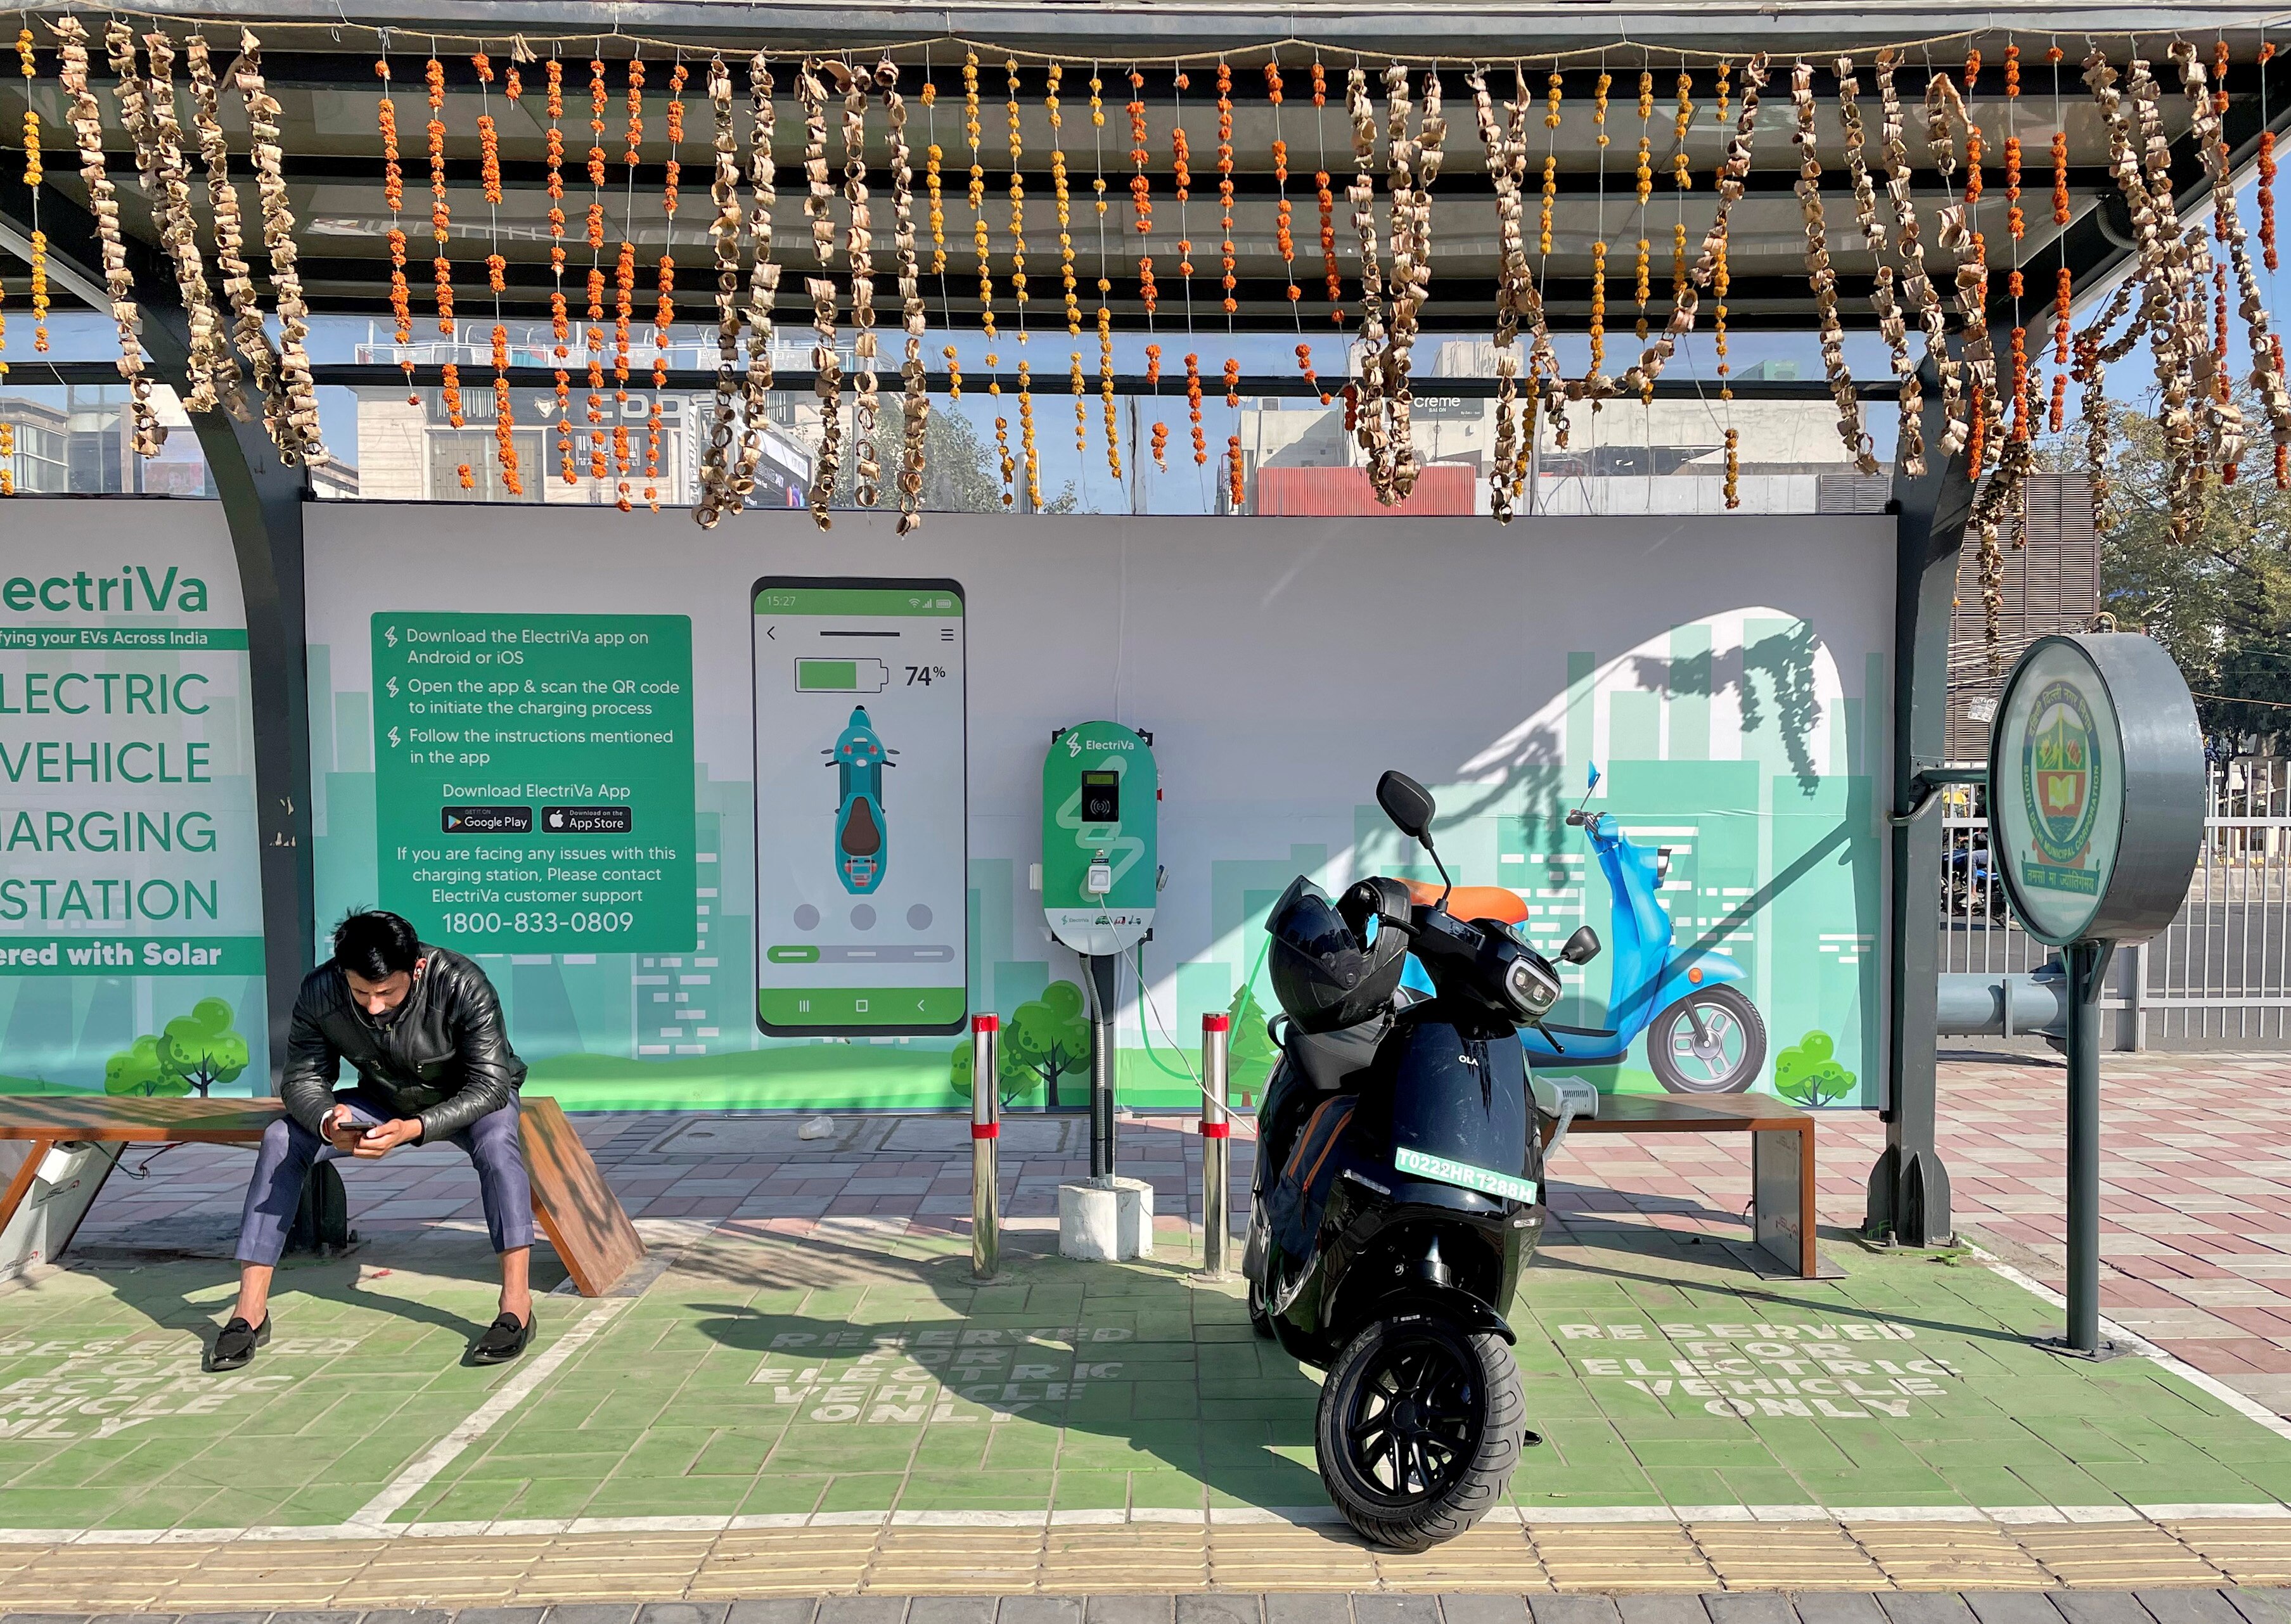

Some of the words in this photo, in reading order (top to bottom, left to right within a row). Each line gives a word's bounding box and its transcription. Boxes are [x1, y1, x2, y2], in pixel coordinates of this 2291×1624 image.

[1414, 397, 1461, 407] creme
[3, 566, 207, 611] ectriVa
[767, 596, 796, 606] 15:27
[41, 634, 75, 646] your
[81, 631, 108, 643] EVs
[113, 631, 165, 644] Across
[170, 632, 207, 644] India
[408, 629, 485, 643] Download
[491, 630, 517, 643] the
[522, 630, 589, 643] ElectriVa
[594, 634, 624, 646] app
[629, 634, 648, 644] on
[408, 650, 470, 663] Android
[476, 654, 492, 663] or
[497, 651, 523, 664] iOS
[0, 673, 210, 715] LECTRIC
[408, 679, 452, 695] Open
[458, 679, 483, 693] the
[489, 683, 518, 695] app
[524, 680, 536, 693] &
[541, 683, 577, 693] scan
[582, 680, 607, 693] the
[613, 680, 636, 693] QR
[641, 681, 679, 693] code
[409, 702, 425, 713] to
[430, 701, 482, 713] initiate
[488, 701, 513, 713] the
[518, 701, 586, 717] charging
[593, 705, 652, 717] process
[410, 729, 459, 742] Follow
[464, 729, 490, 742] the
[496, 729, 585, 742] instructions
[591, 730, 672, 743] mentioned
[1086, 740, 1134, 750] ElectriVa
[0, 742, 212, 783] VEHICLE
[411, 750, 423, 763] in
[429, 750, 454, 763] the
[459, 753, 490, 766] app
[444, 784, 521, 797] Download
[527, 784, 593, 797] ElectriVa
[598, 784, 630, 800] App
[2024, 765, 2032, 809] SOUTH
[2030, 811, 2044, 843] DELHI
[2044, 840, 2075, 859] MUNICIPAL
[2075, 765, 2099, 850] CORPORATION
[465, 817, 502, 829] Google
[505, 817, 527, 829] Play
[569, 819, 592, 830] App
[594, 819, 624, 829] Store
[0, 812, 216, 852] ARGING
[398, 847, 407, 860] If
[412, 850, 440, 863] you
[446, 850, 470, 860] are
[475, 847, 522, 863] facing
[528, 850, 555, 862] any
[561, 850, 606, 859] issues
[612, 847, 643, 859] with
[649, 847, 676, 859] this
[413, 869, 480, 884] charging
[486, 868, 542, 882] station,
[548, 868, 597, 881] Please
[603, 869, 661, 880] contact
[2049, 872, 2057, 885] मा
[0, 879, 217, 920] STATION
[433, 889, 499, 902] ElectriVa
[504, 890, 577, 902] customer
[582, 890, 643, 904] support
[443, 912, 632, 933] 1800-833-0809
[67, 942, 133, 965] with
[143, 942, 221, 965] Solar
[1458, 1054, 1479, 1066] OLA
[769, 1328, 1133, 1348] RESERVED
[1558, 1324, 1915, 1339] RESERVED
[1685, 1342, 1859, 1358] FOR
[754, 1362, 1124, 1383] ELECTRIC
[1581, 1359, 1963, 1376] ELECTRIC
[774, 1383, 1087, 1403] VEHICLE
[1624, 1378, 1948, 1395] VEHICLE
[1704, 1398, 1911, 1417] ONLY
